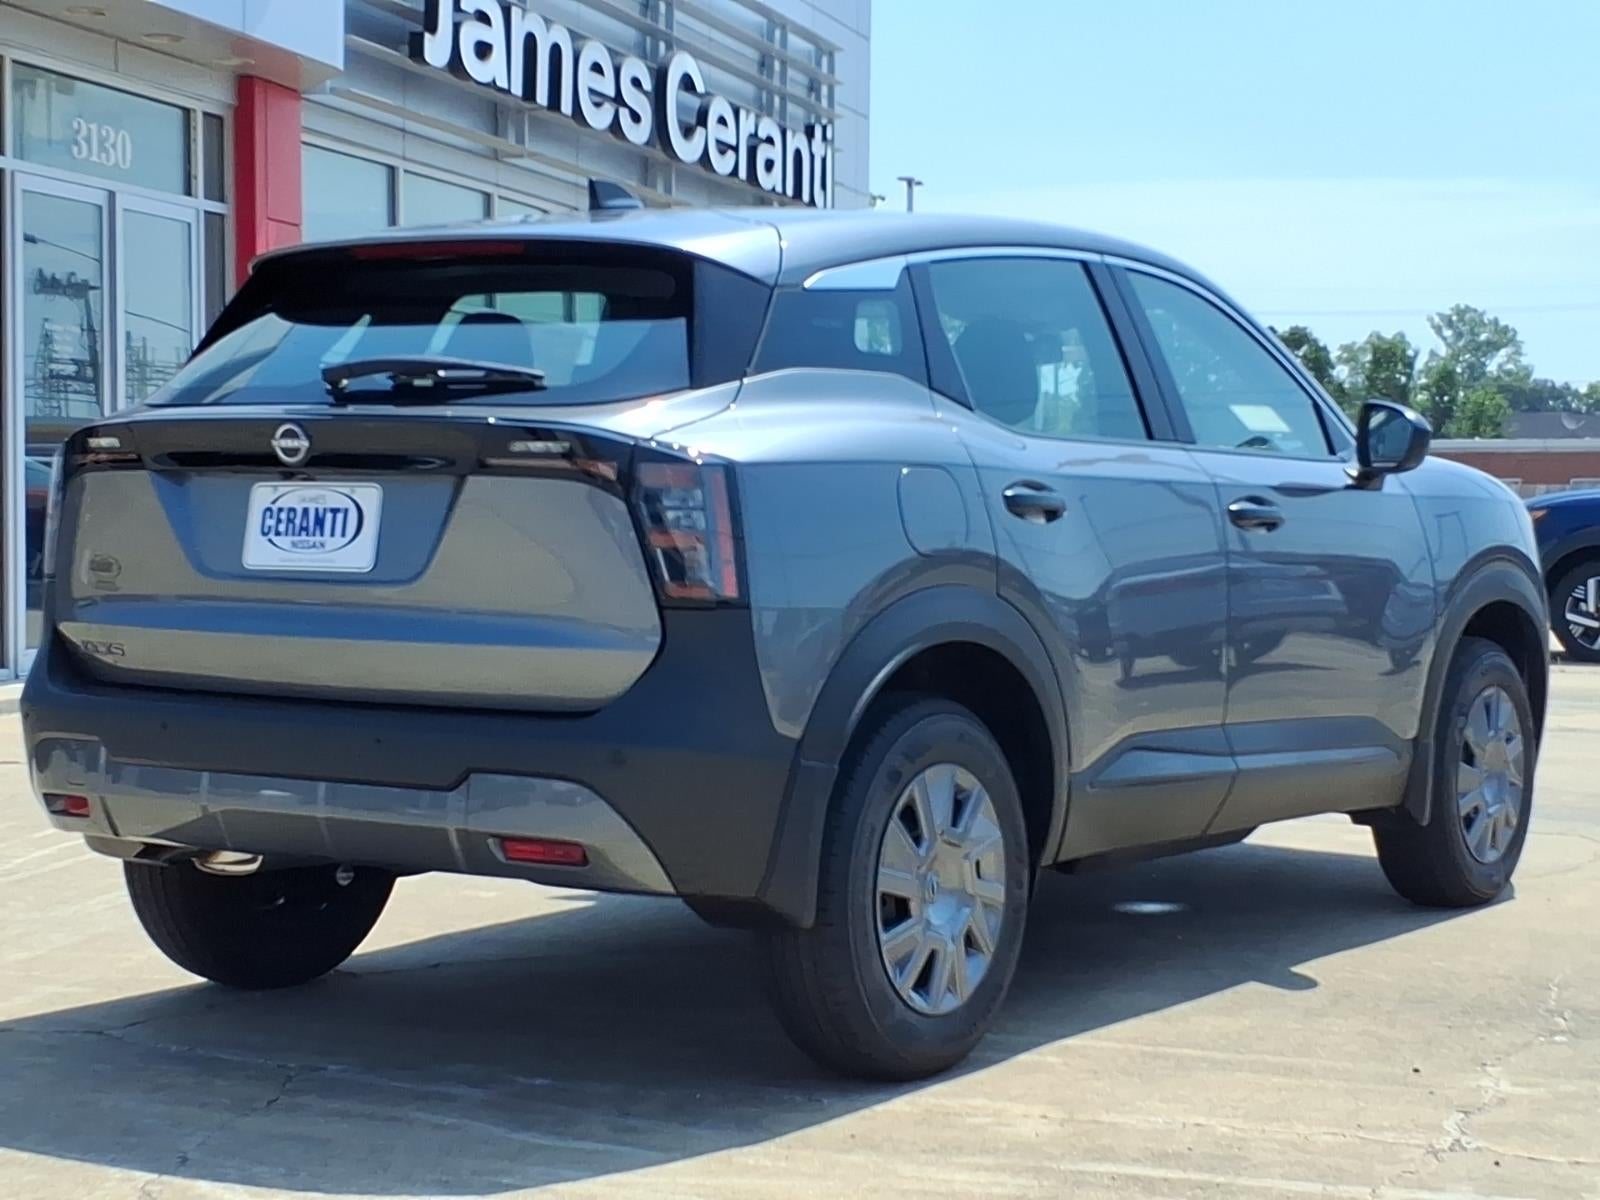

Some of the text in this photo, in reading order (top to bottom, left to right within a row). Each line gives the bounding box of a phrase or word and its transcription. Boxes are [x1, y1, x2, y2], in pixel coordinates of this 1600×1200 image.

[423, 0, 833, 209] James Ceranti
[71, 117, 132, 169] 3130
[261, 506, 349, 538] CERANTI
